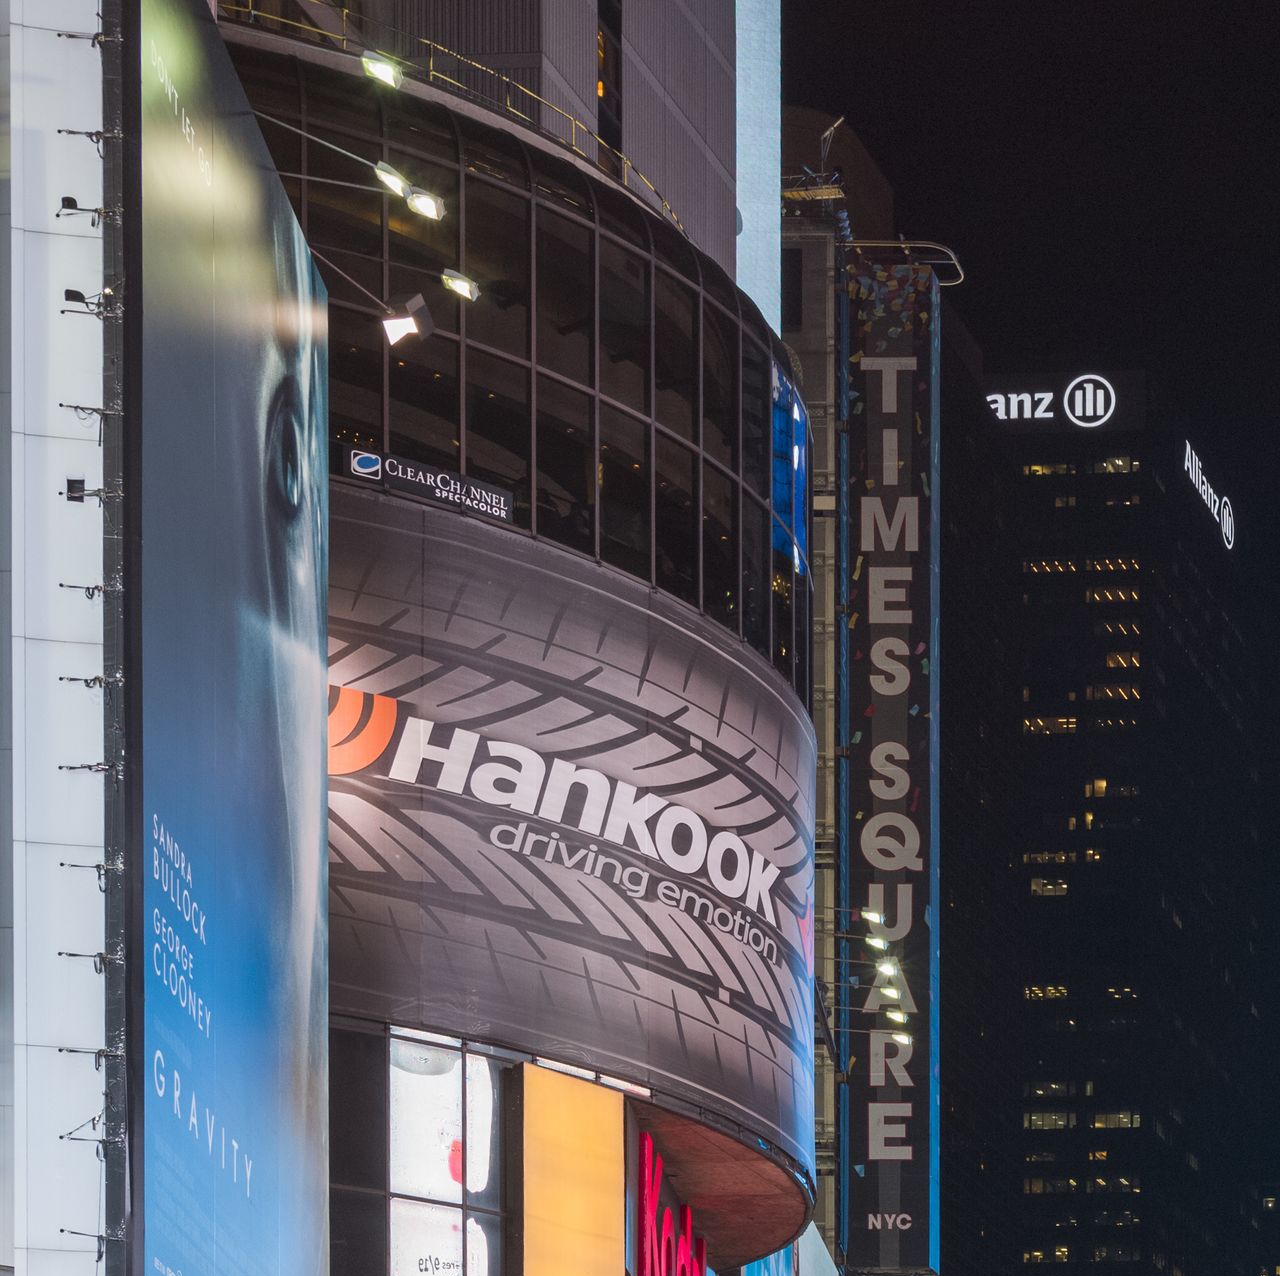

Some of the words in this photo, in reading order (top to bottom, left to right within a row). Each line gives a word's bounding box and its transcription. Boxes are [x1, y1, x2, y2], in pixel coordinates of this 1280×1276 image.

[182, 107, 195, 152] LET
[435, 488, 507, 519] SPECTACOLOR
[1184, 439, 1221, 524] Allianz
[860, 356, 919, 696] TIMES
[152, 813, 194, 889] SANDRA
[489, 821, 649, 897] driving
[152, 846, 207, 946] BULLOCK
[657, 876, 781, 965] emotion
[152, 907, 195, 980] GEORGE
[860, 740, 924, 1161] SQUARE
[152, 942, 212, 1039] CLOONEY
[152, 1050, 255, 1200] GRAVITY
[867, 1213, 912, 1230] NYC
